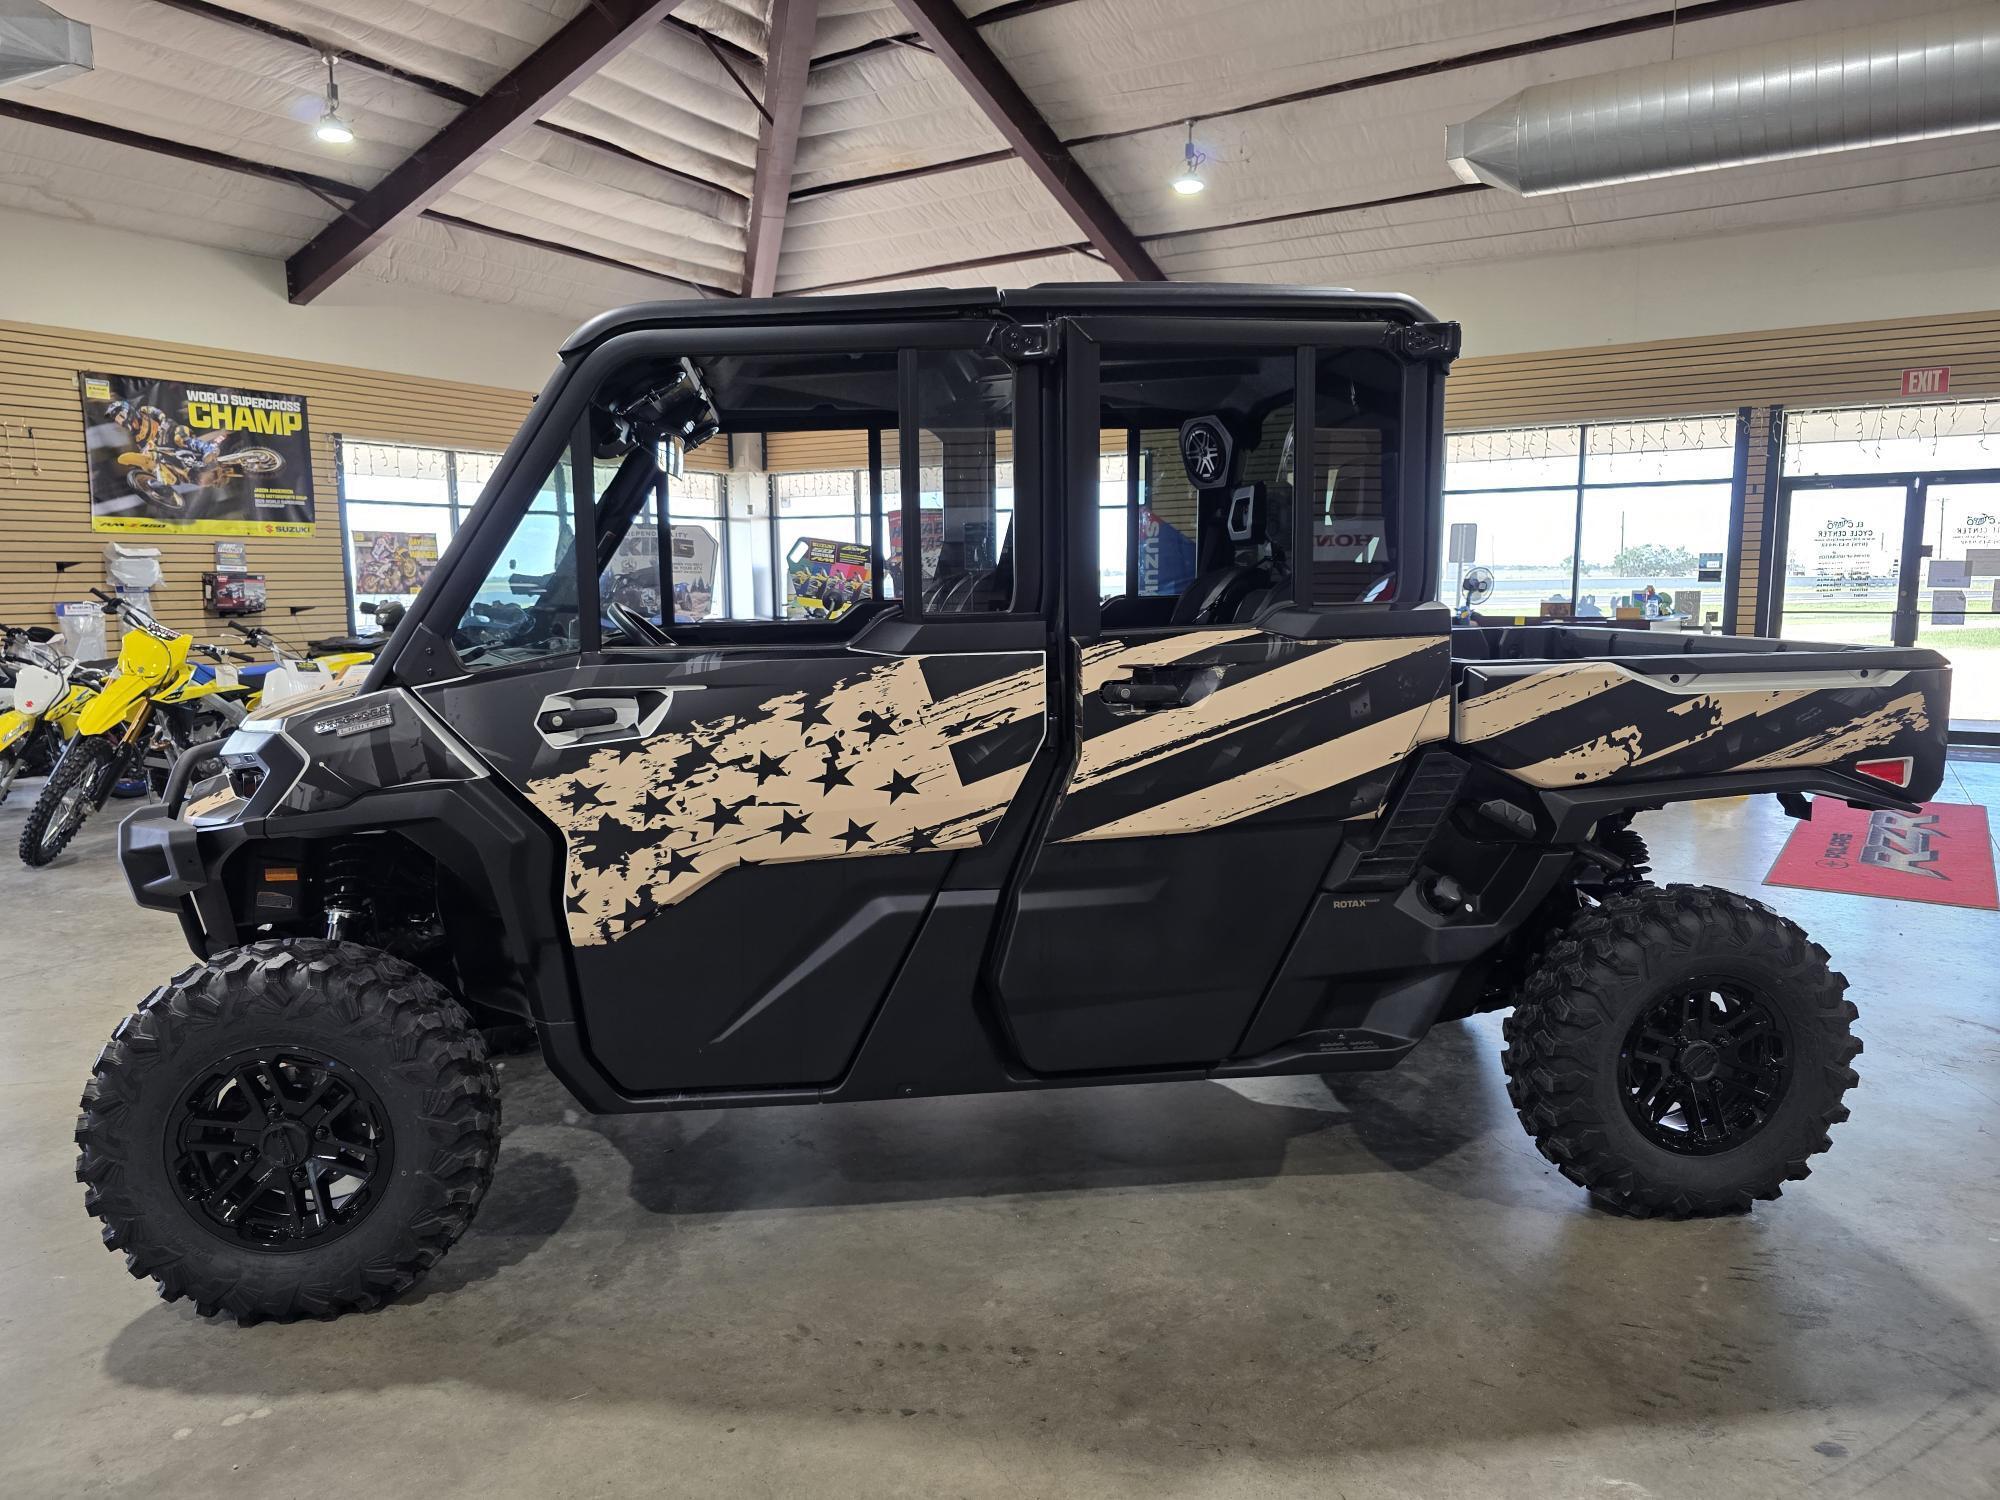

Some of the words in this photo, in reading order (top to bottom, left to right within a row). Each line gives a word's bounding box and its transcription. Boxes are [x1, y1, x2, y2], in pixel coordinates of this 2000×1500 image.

[1909, 370, 1942, 392] EXIT
[186, 390, 228, 404] WORLD
[231, 395, 301, 412] SUPERCROSS
[188, 402, 302, 436] CHAMP
[1145, 521, 1160, 596] SUZUK
[1825, 832, 1852, 858] POLARIS
[1859, 810, 1951, 880] RZR
[1333, 900, 1367, 909] ROTAX
